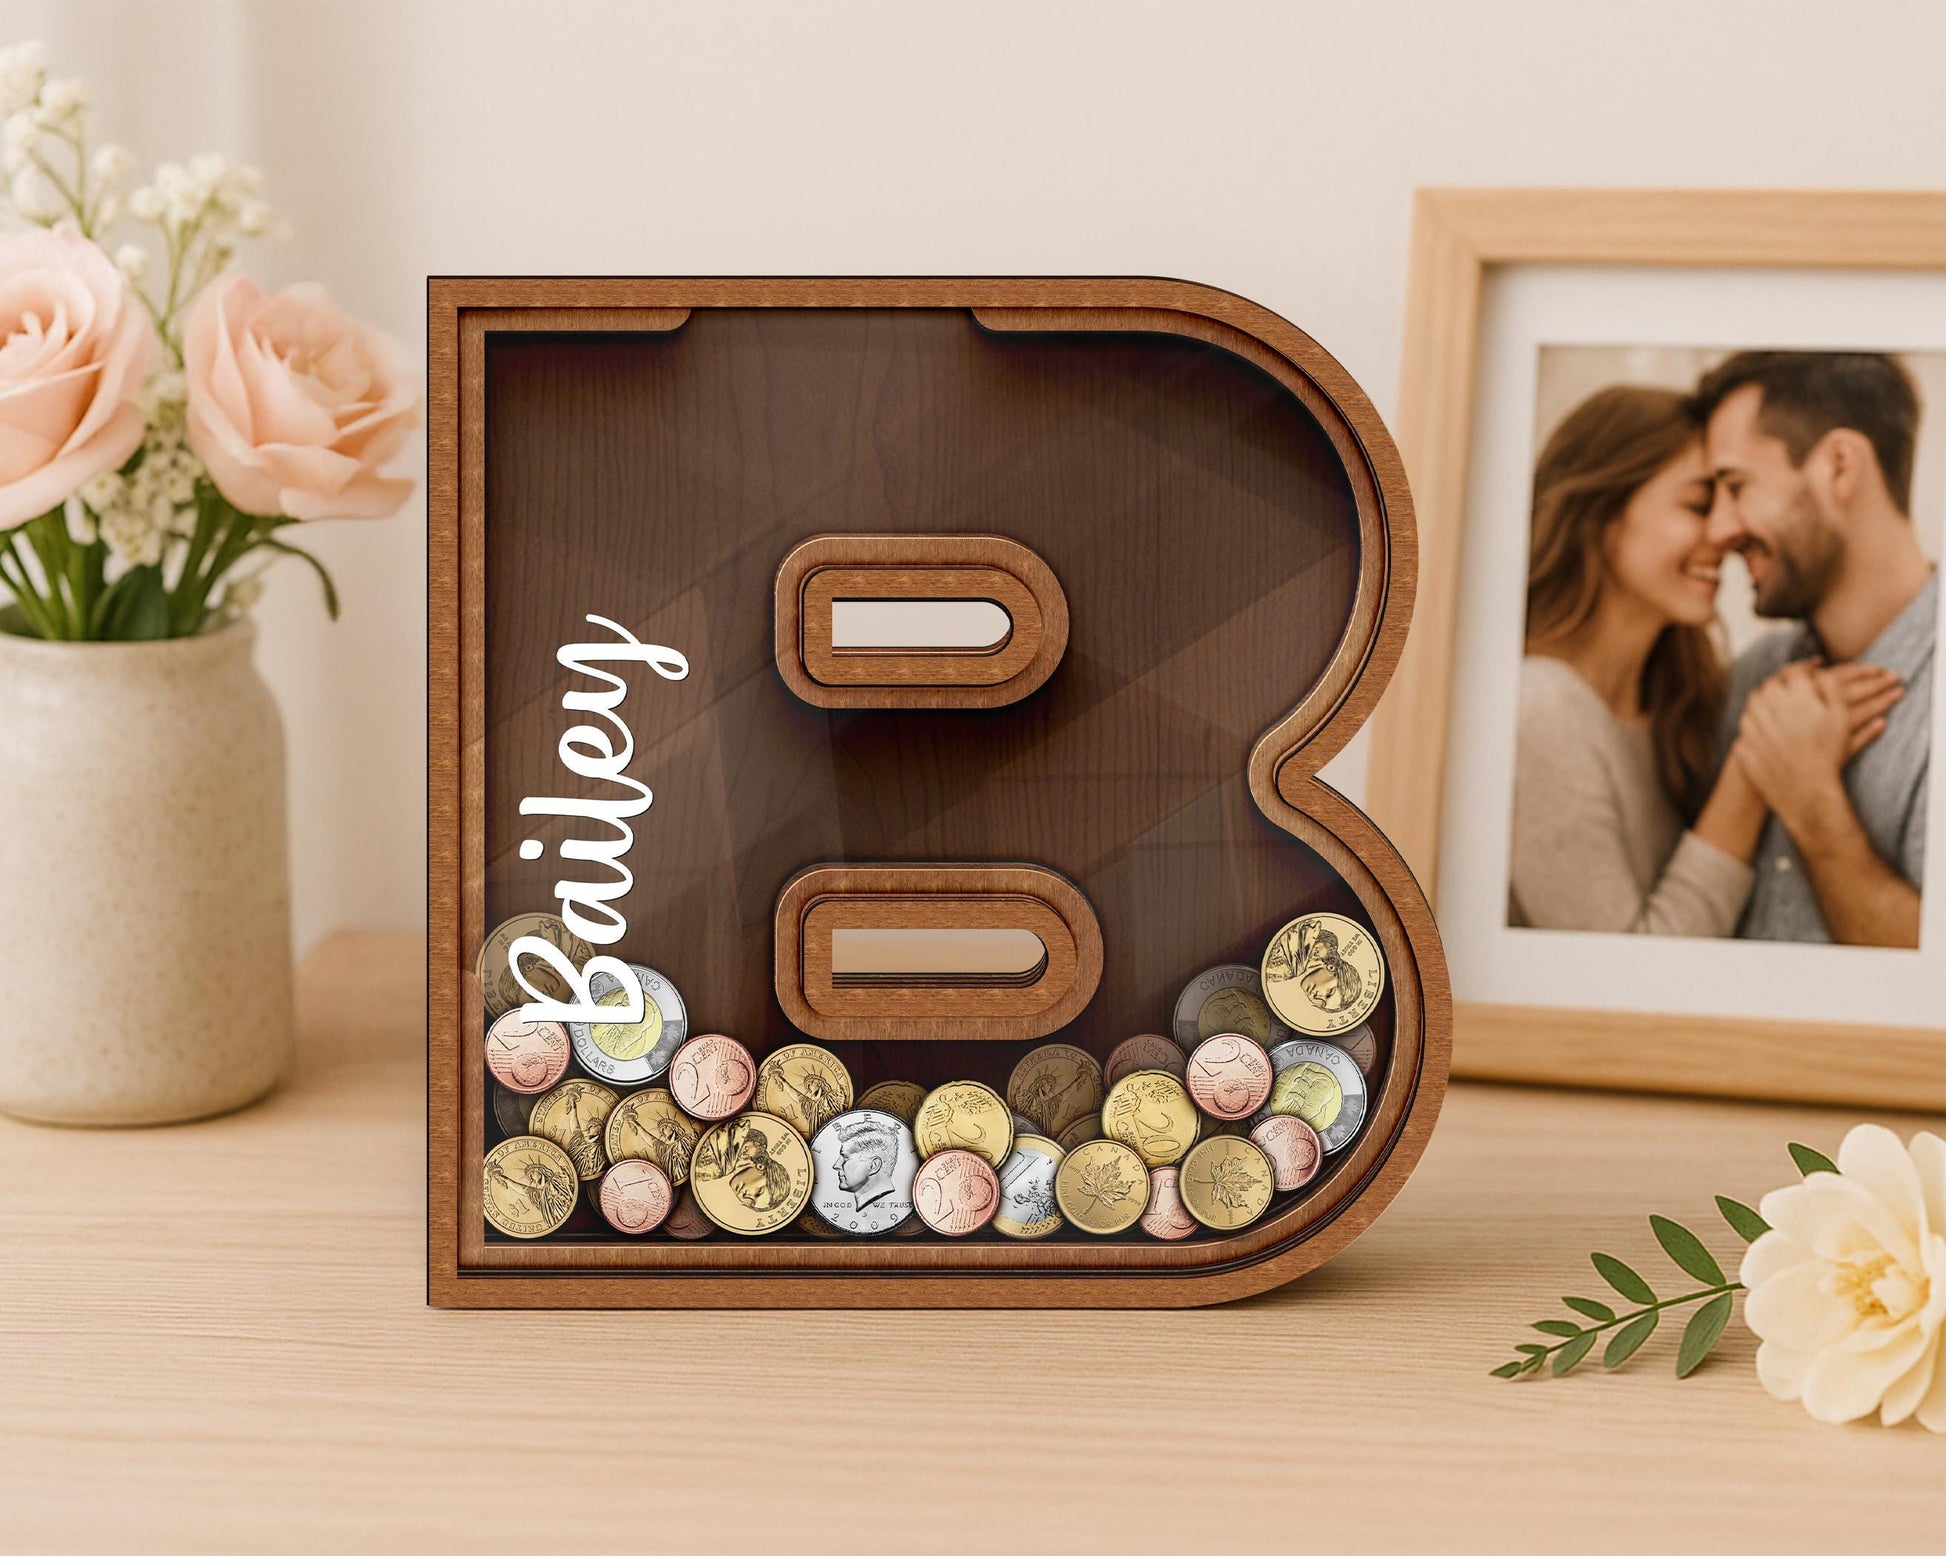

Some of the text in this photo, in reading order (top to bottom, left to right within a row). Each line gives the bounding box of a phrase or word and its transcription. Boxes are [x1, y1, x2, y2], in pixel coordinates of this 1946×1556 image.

[508, 613, 689, 1024] Bailey
[1326, 969, 1378, 1029] LIBERTY
[573, 1028, 616, 1075] DOLLARS
[783, 1049, 796, 1060] OF
[1195, 1039, 1241, 1078] 2
[1286, 1045, 1341, 1066] CANADA
[676, 1062, 711, 1109] 2
[497, 1145, 511, 1158] OF
[1133, 1111, 1181, 1158] 20
[1082, 1146, 1145, 1185] CANADA
[1186, 1160, 1199, 1182] GOLD
[1245, 1147, 1268, 1217] CANADA
[755, 1168, 807, 1229] LIBERTY
[919, 1177, 954, 1225] 2
[1061, 1180, 1070, 1200] FINE
[1066, 1200, 1086, 1220] GOLD
[502, 1218, 543, 1233] UNITED
[831, 1213, 898, 1231] 2009
